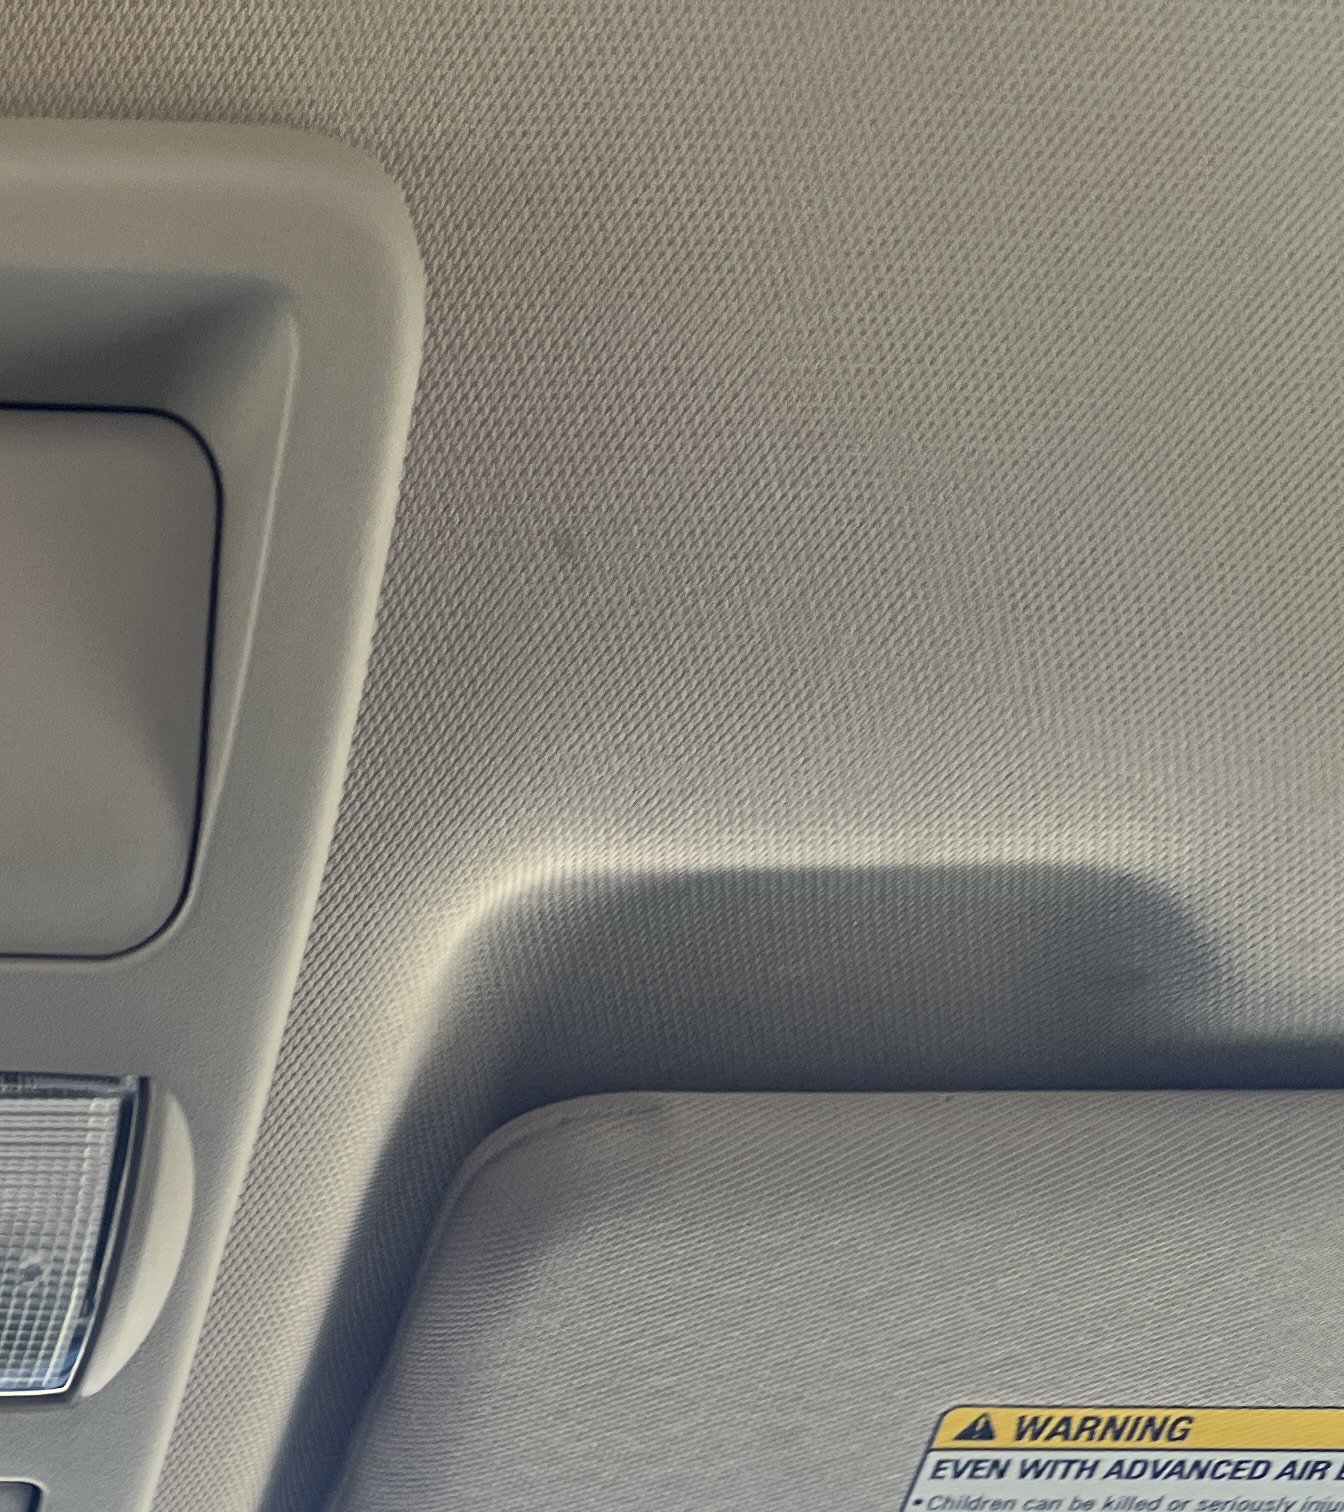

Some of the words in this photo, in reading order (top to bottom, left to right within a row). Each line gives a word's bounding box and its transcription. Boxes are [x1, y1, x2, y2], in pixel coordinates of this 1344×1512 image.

[1015, 1415, 1195, 1442] WARNING
[929, 1459, 1011, 1480] EVEN
[1018, 1459, 1101, 1480] WITH
[1102, 1459, 1273, 1481] ADVANCED
[1274, 1460, 1333, 1481] AIR
[926, 1494, 1015, 1511] Children
[1022, 1498, 1062, 1511] can
[1068, 1496, 1095, 1512] be
[1101, 1495, 1164, 1512] killed
[1167, 1499, 1191, 1512] or
